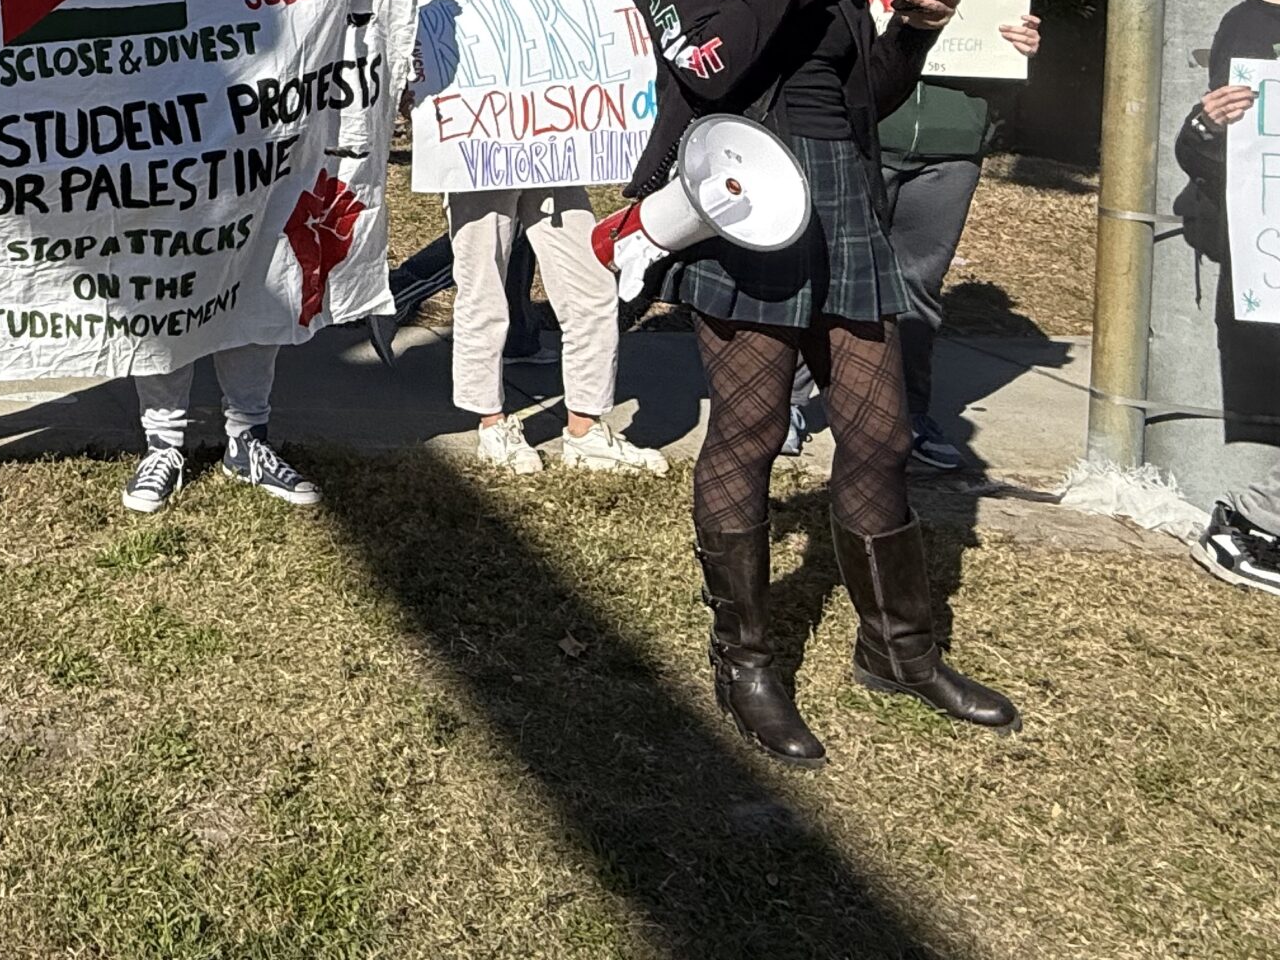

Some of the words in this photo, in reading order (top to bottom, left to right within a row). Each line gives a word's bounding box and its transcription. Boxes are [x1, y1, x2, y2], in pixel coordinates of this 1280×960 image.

[118, 39, 142, 75] &
[144, 21, 261, 67] DIVEST
[927, 61, 947, 72] SDS
[226, 53, 382, 135] PROTESTS
[432, 83, 627, 143] EXPULSION
[59, 135, 300, 213] PALESTINE
[458, 135, 580, 189] VICTORIA
[7, 235, 98, 262] STOP
[99, 214, 254, 258] ATTACKS
[72, 272, 120, 300] ON
[128, 271, 197, 301] THE
[105, 281, 240, 337] MOVEMENT
